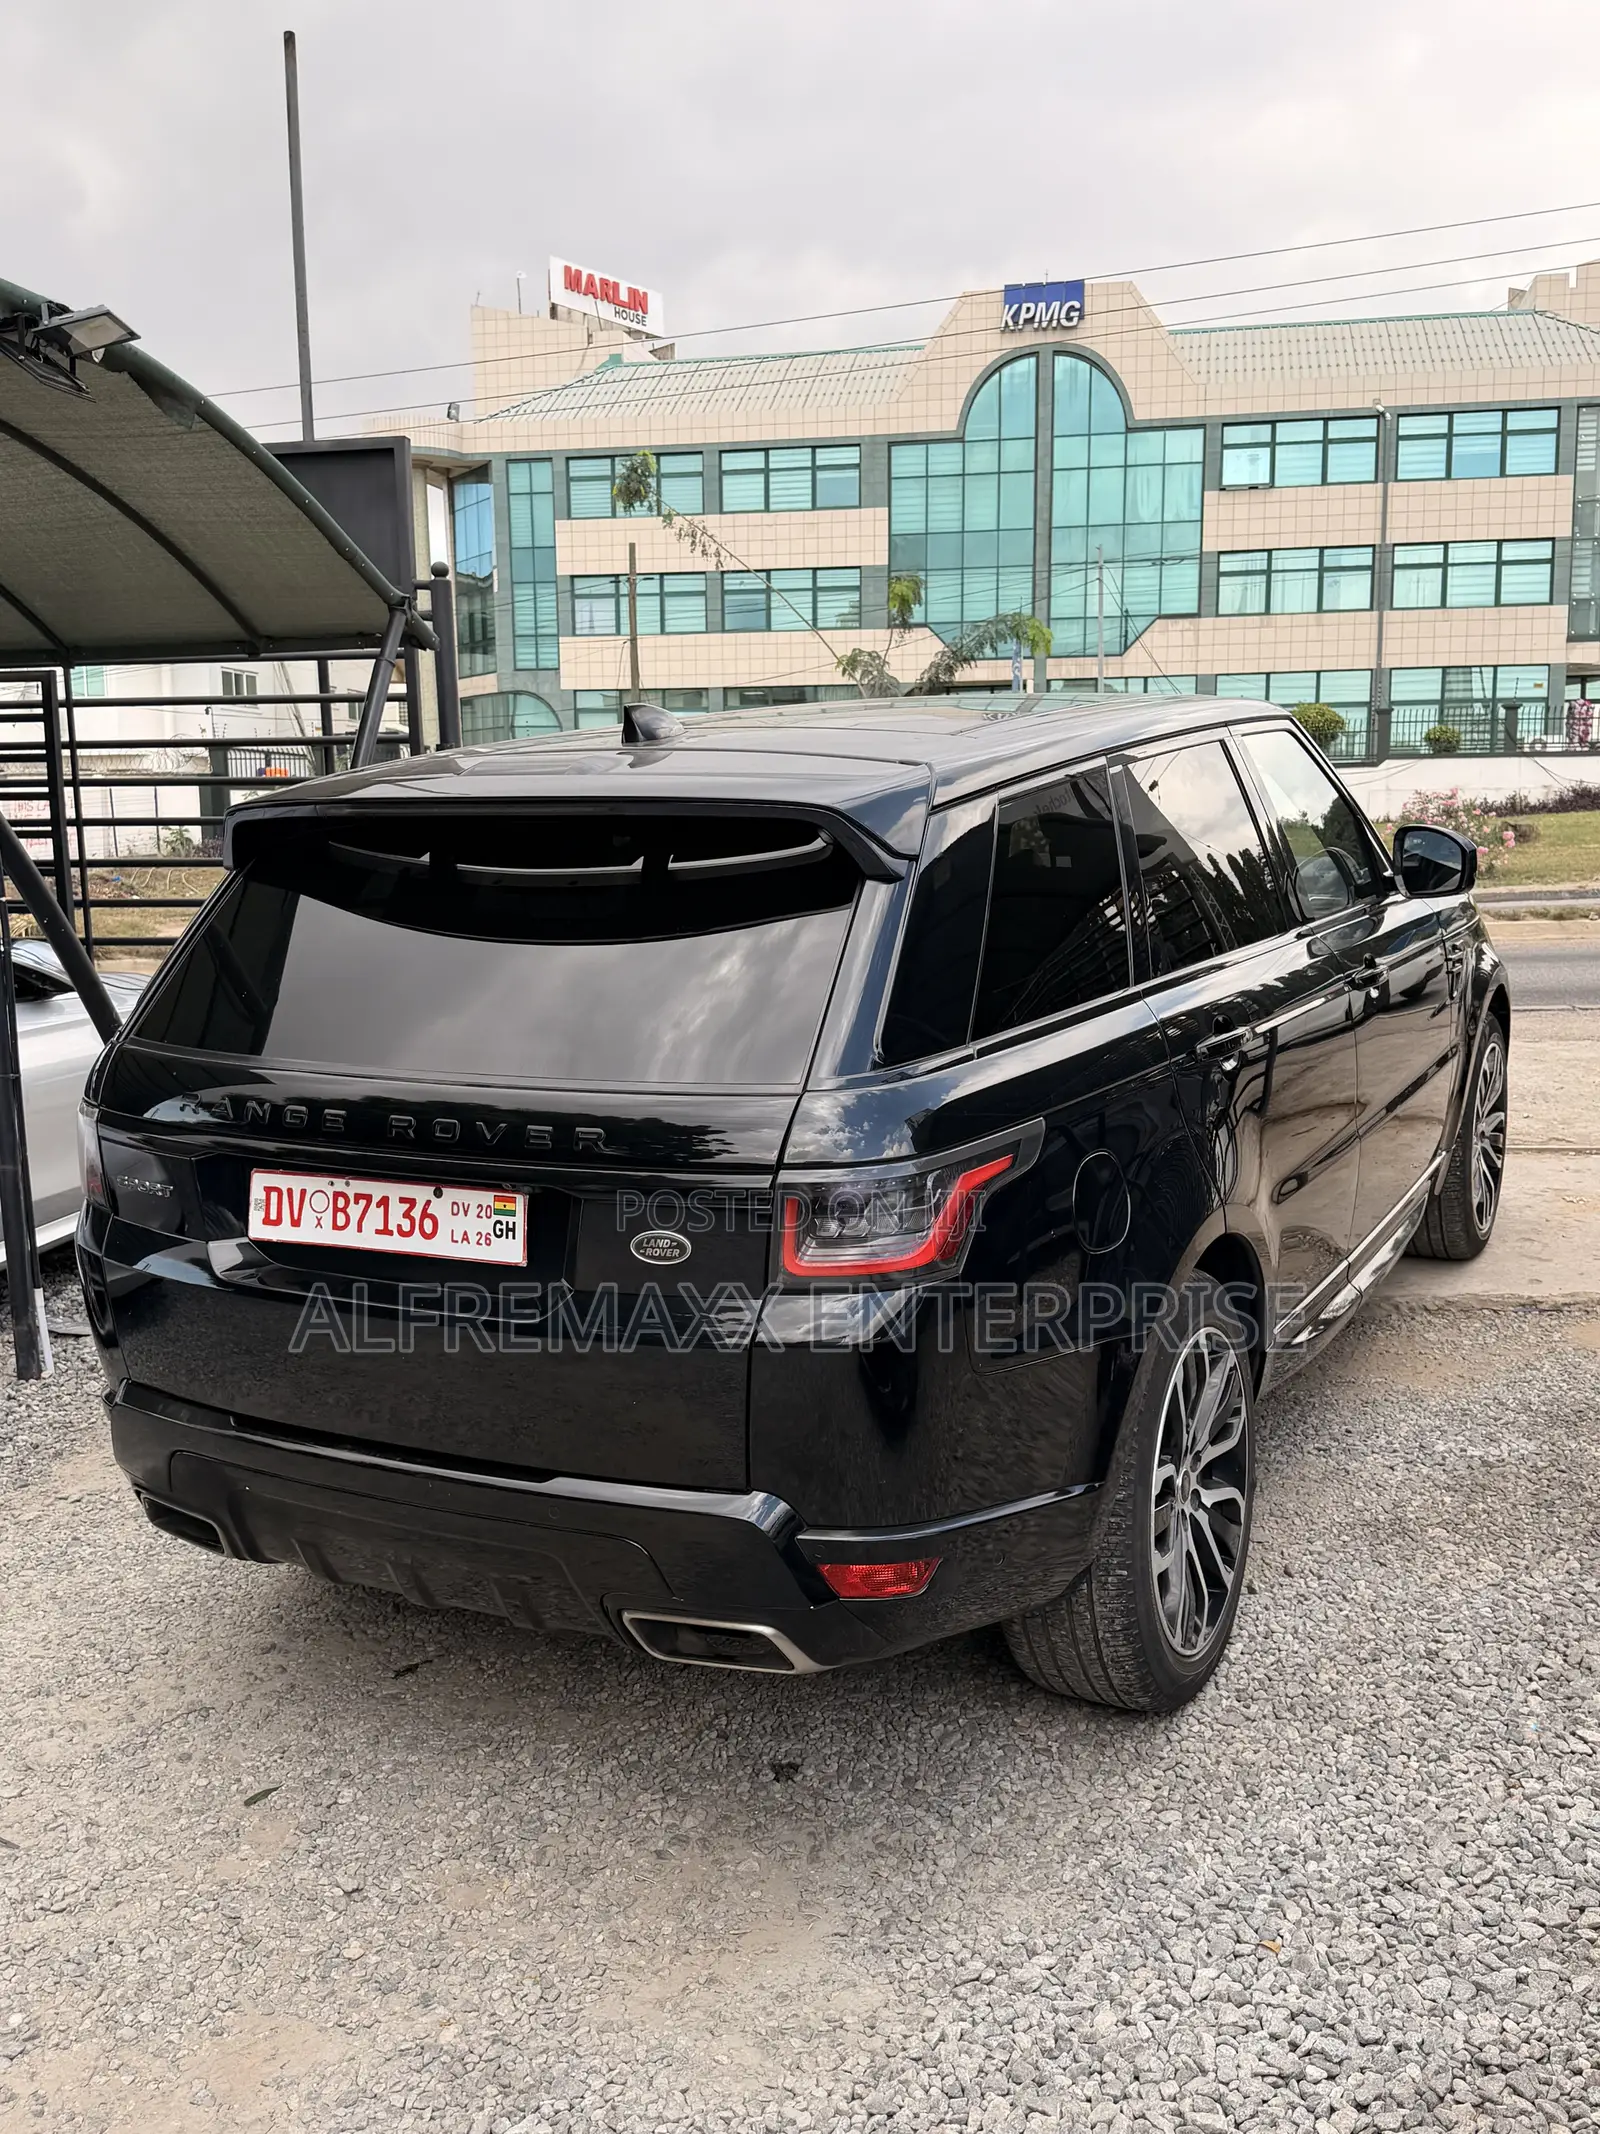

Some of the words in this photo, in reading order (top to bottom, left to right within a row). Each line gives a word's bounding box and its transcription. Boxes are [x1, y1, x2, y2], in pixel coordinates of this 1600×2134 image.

[564, 265, 649, 315] MARLIN
[614, 307, 648, 327] HOUSE
[1000, 300, 1081, 331] KPMG
[179, 1093, 347, 1132] RANGE
[387, 1114, 608, 1153] ROVER
[262, 1186, 307, 1228] DV
[332, 1190, 439, 1241] B7136
[451, 1201, 470, 1217] DV
[476, 1204, 492, 1220] 20
[451, 1229, 471, 1245] LA
[476, 1231, 492, 1247] 26
[493, 1220, 516, 1241] GH
[643, 1239, 671, 1248] LAND
[645, 1247, 680, 1257] ROVER
